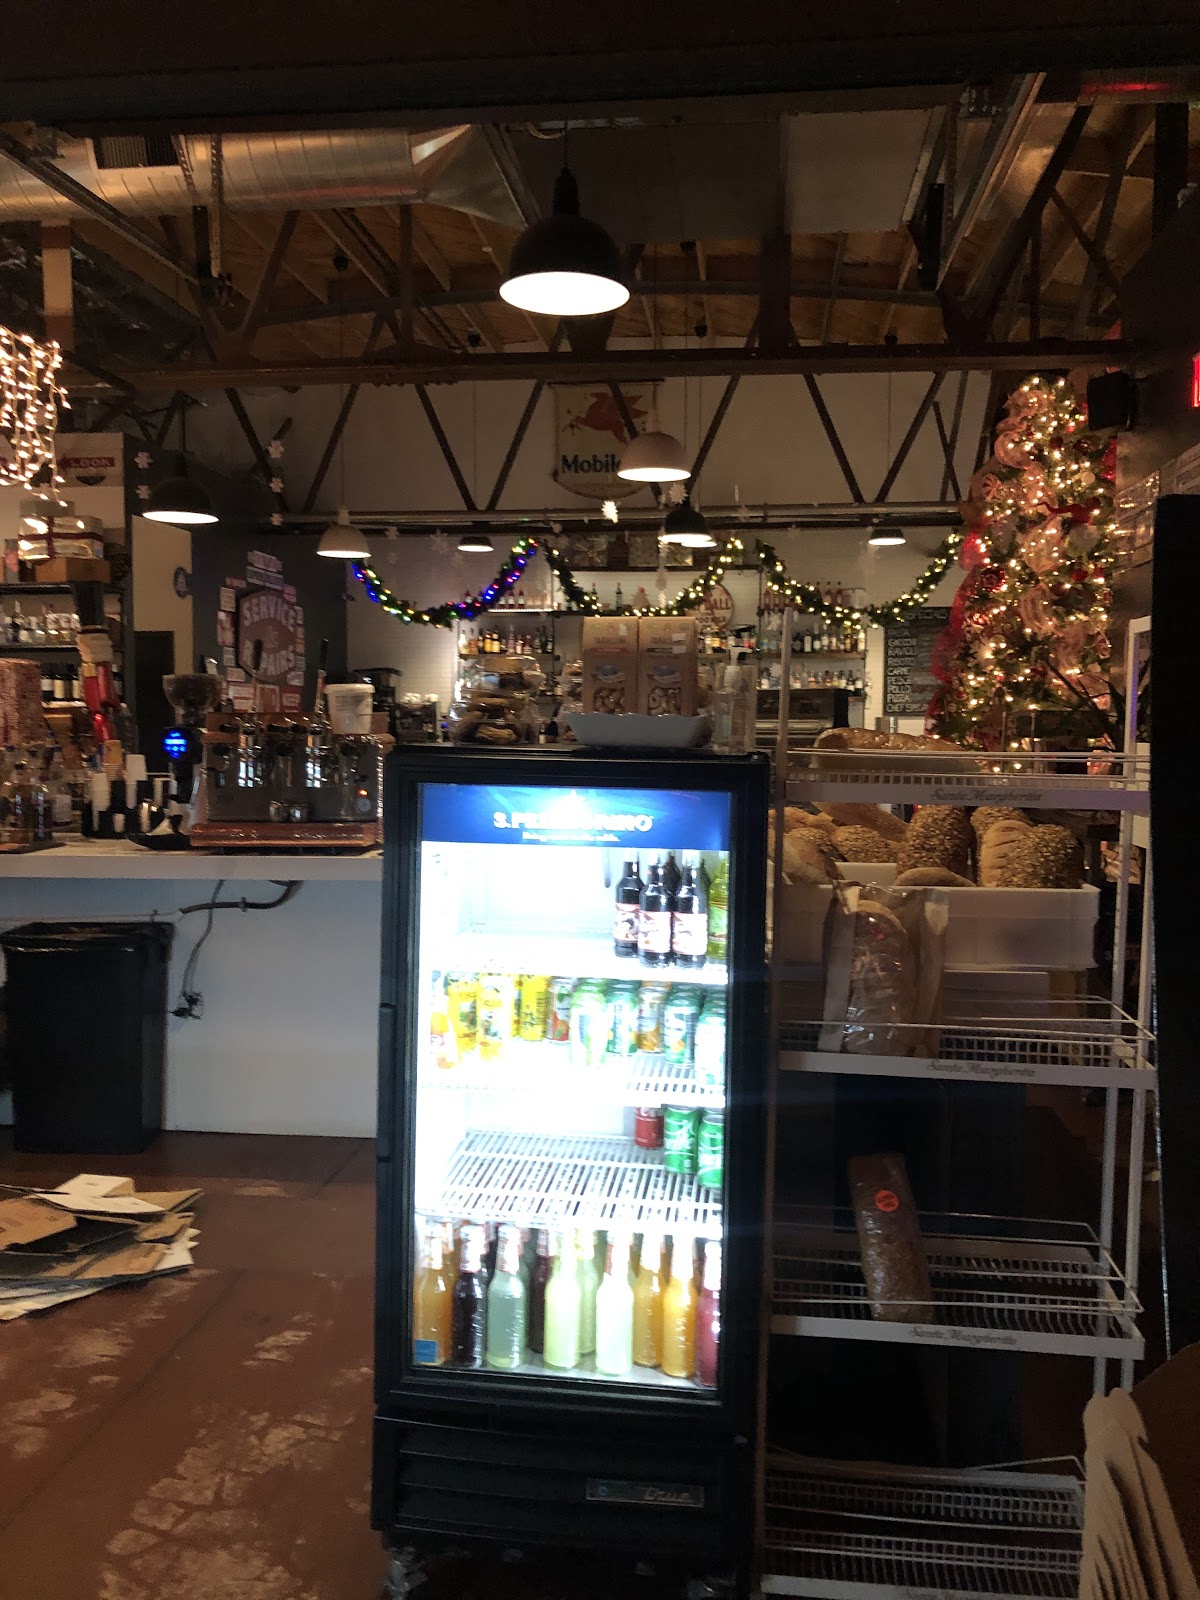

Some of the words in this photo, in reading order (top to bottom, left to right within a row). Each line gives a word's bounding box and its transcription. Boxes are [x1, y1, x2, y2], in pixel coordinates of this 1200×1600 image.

[561, 453, 620, 473] Mobil
[243, 595, 296, 632] SERVICE
[243, 639, 297, 676] RPAIRS
